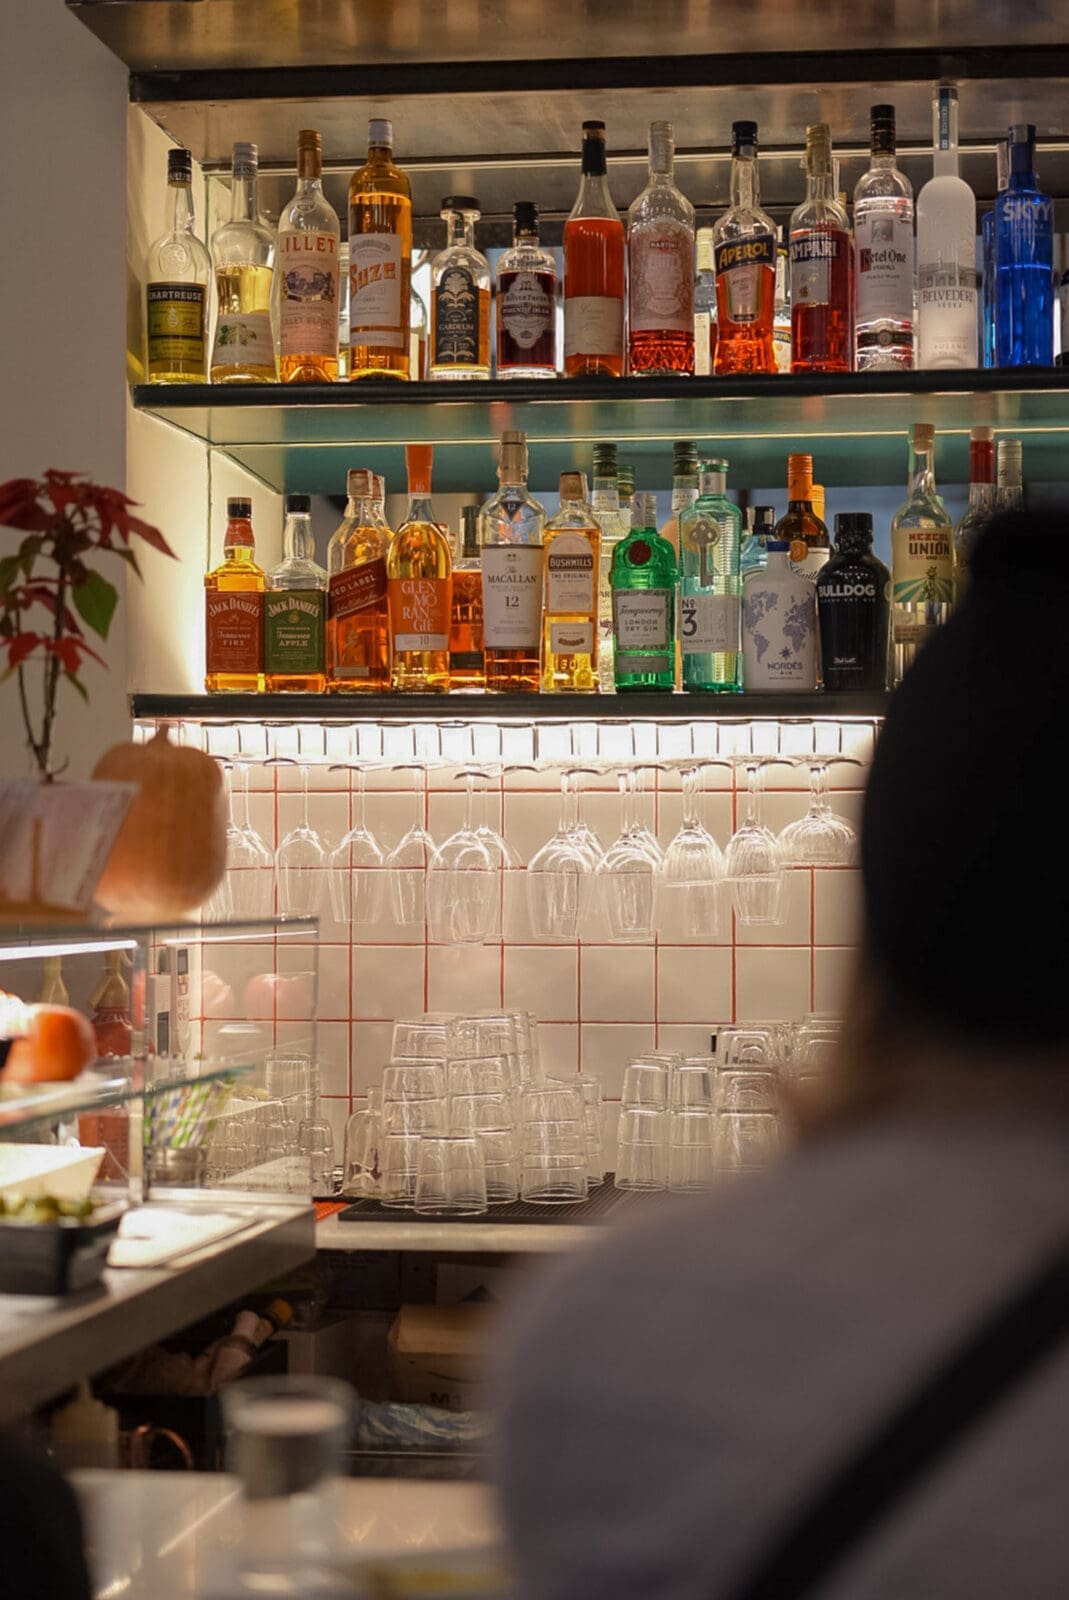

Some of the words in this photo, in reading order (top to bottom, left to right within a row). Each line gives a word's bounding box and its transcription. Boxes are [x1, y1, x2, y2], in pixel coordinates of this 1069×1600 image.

[1003, 201, 1050, 221] SKYY
[281, 236, 335, 253] ILLET
[790, 240, 837, 259] AMPARI
[720, 242, 769, 268] APEROL
[888, 249, 906, 263] One
[922, 290, 974, 303] BELVEDERE
[550, 558, 593, 567] BUSHMILLS
[348, 574, 376, 590] LABEL
[488, 575, 537, 583] MACALLAN
[401, 581, 436, 593] GLEN
[818, 584, 876, 597] BULLDOG
[414, 593, 438, 607] MO
[505, 596, 520, 608] 12
[209, 600, 230, 617] JACK
[268, 599, 289, 618] JACK
[403, 607, 430, 619] RAN
[413, 618, 433, 632] GIE
[682, 609, 698, 637] 3
[420, 635, 430, 645] 10
